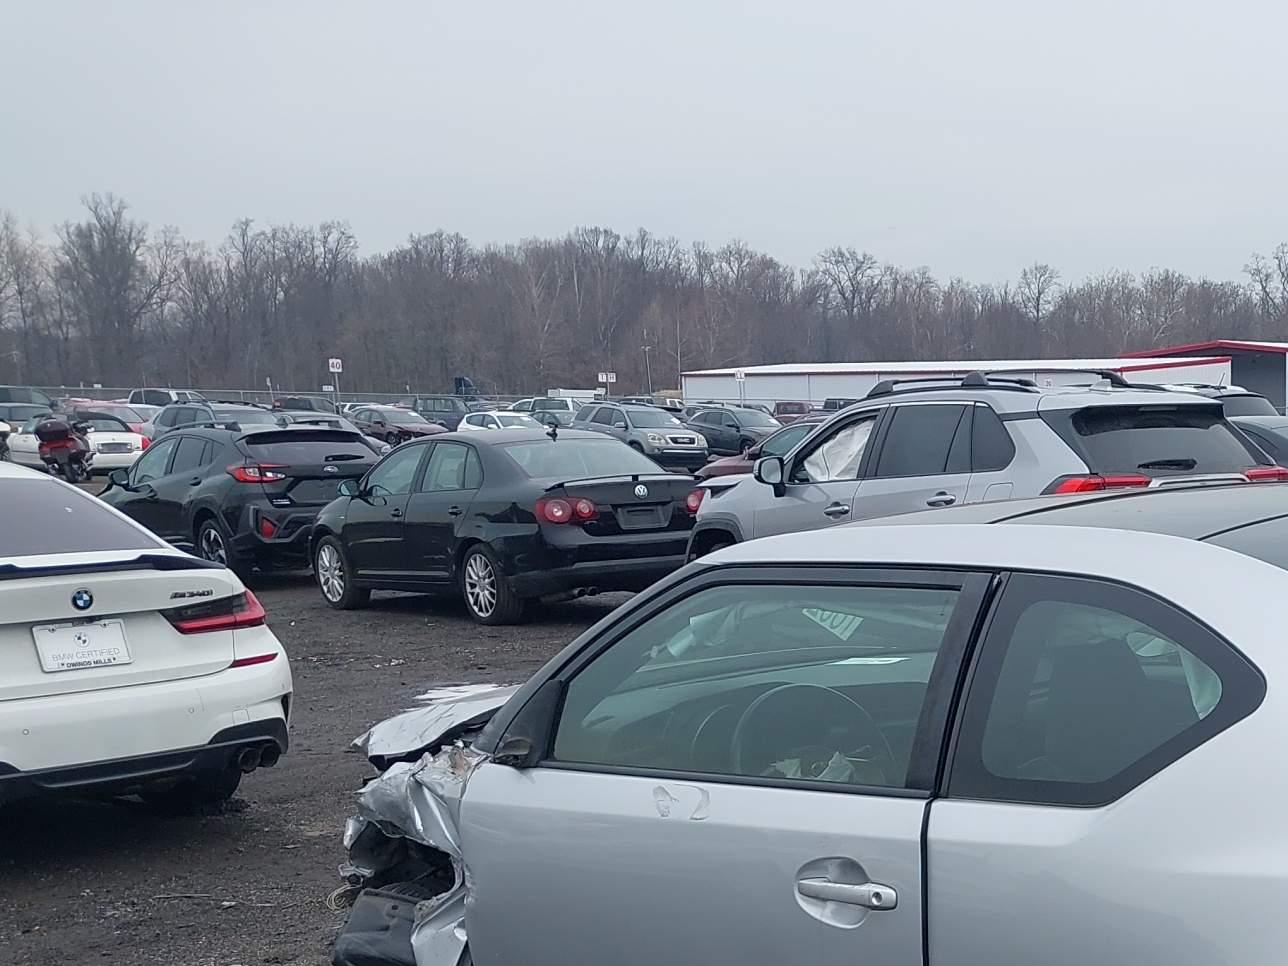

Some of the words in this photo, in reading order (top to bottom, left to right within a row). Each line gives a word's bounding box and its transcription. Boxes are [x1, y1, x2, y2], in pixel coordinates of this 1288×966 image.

[330, 361, 341, 370] 40
[52, 653, 74, 662] BMW
[76, 648, 120, 659] CERTIFIED
